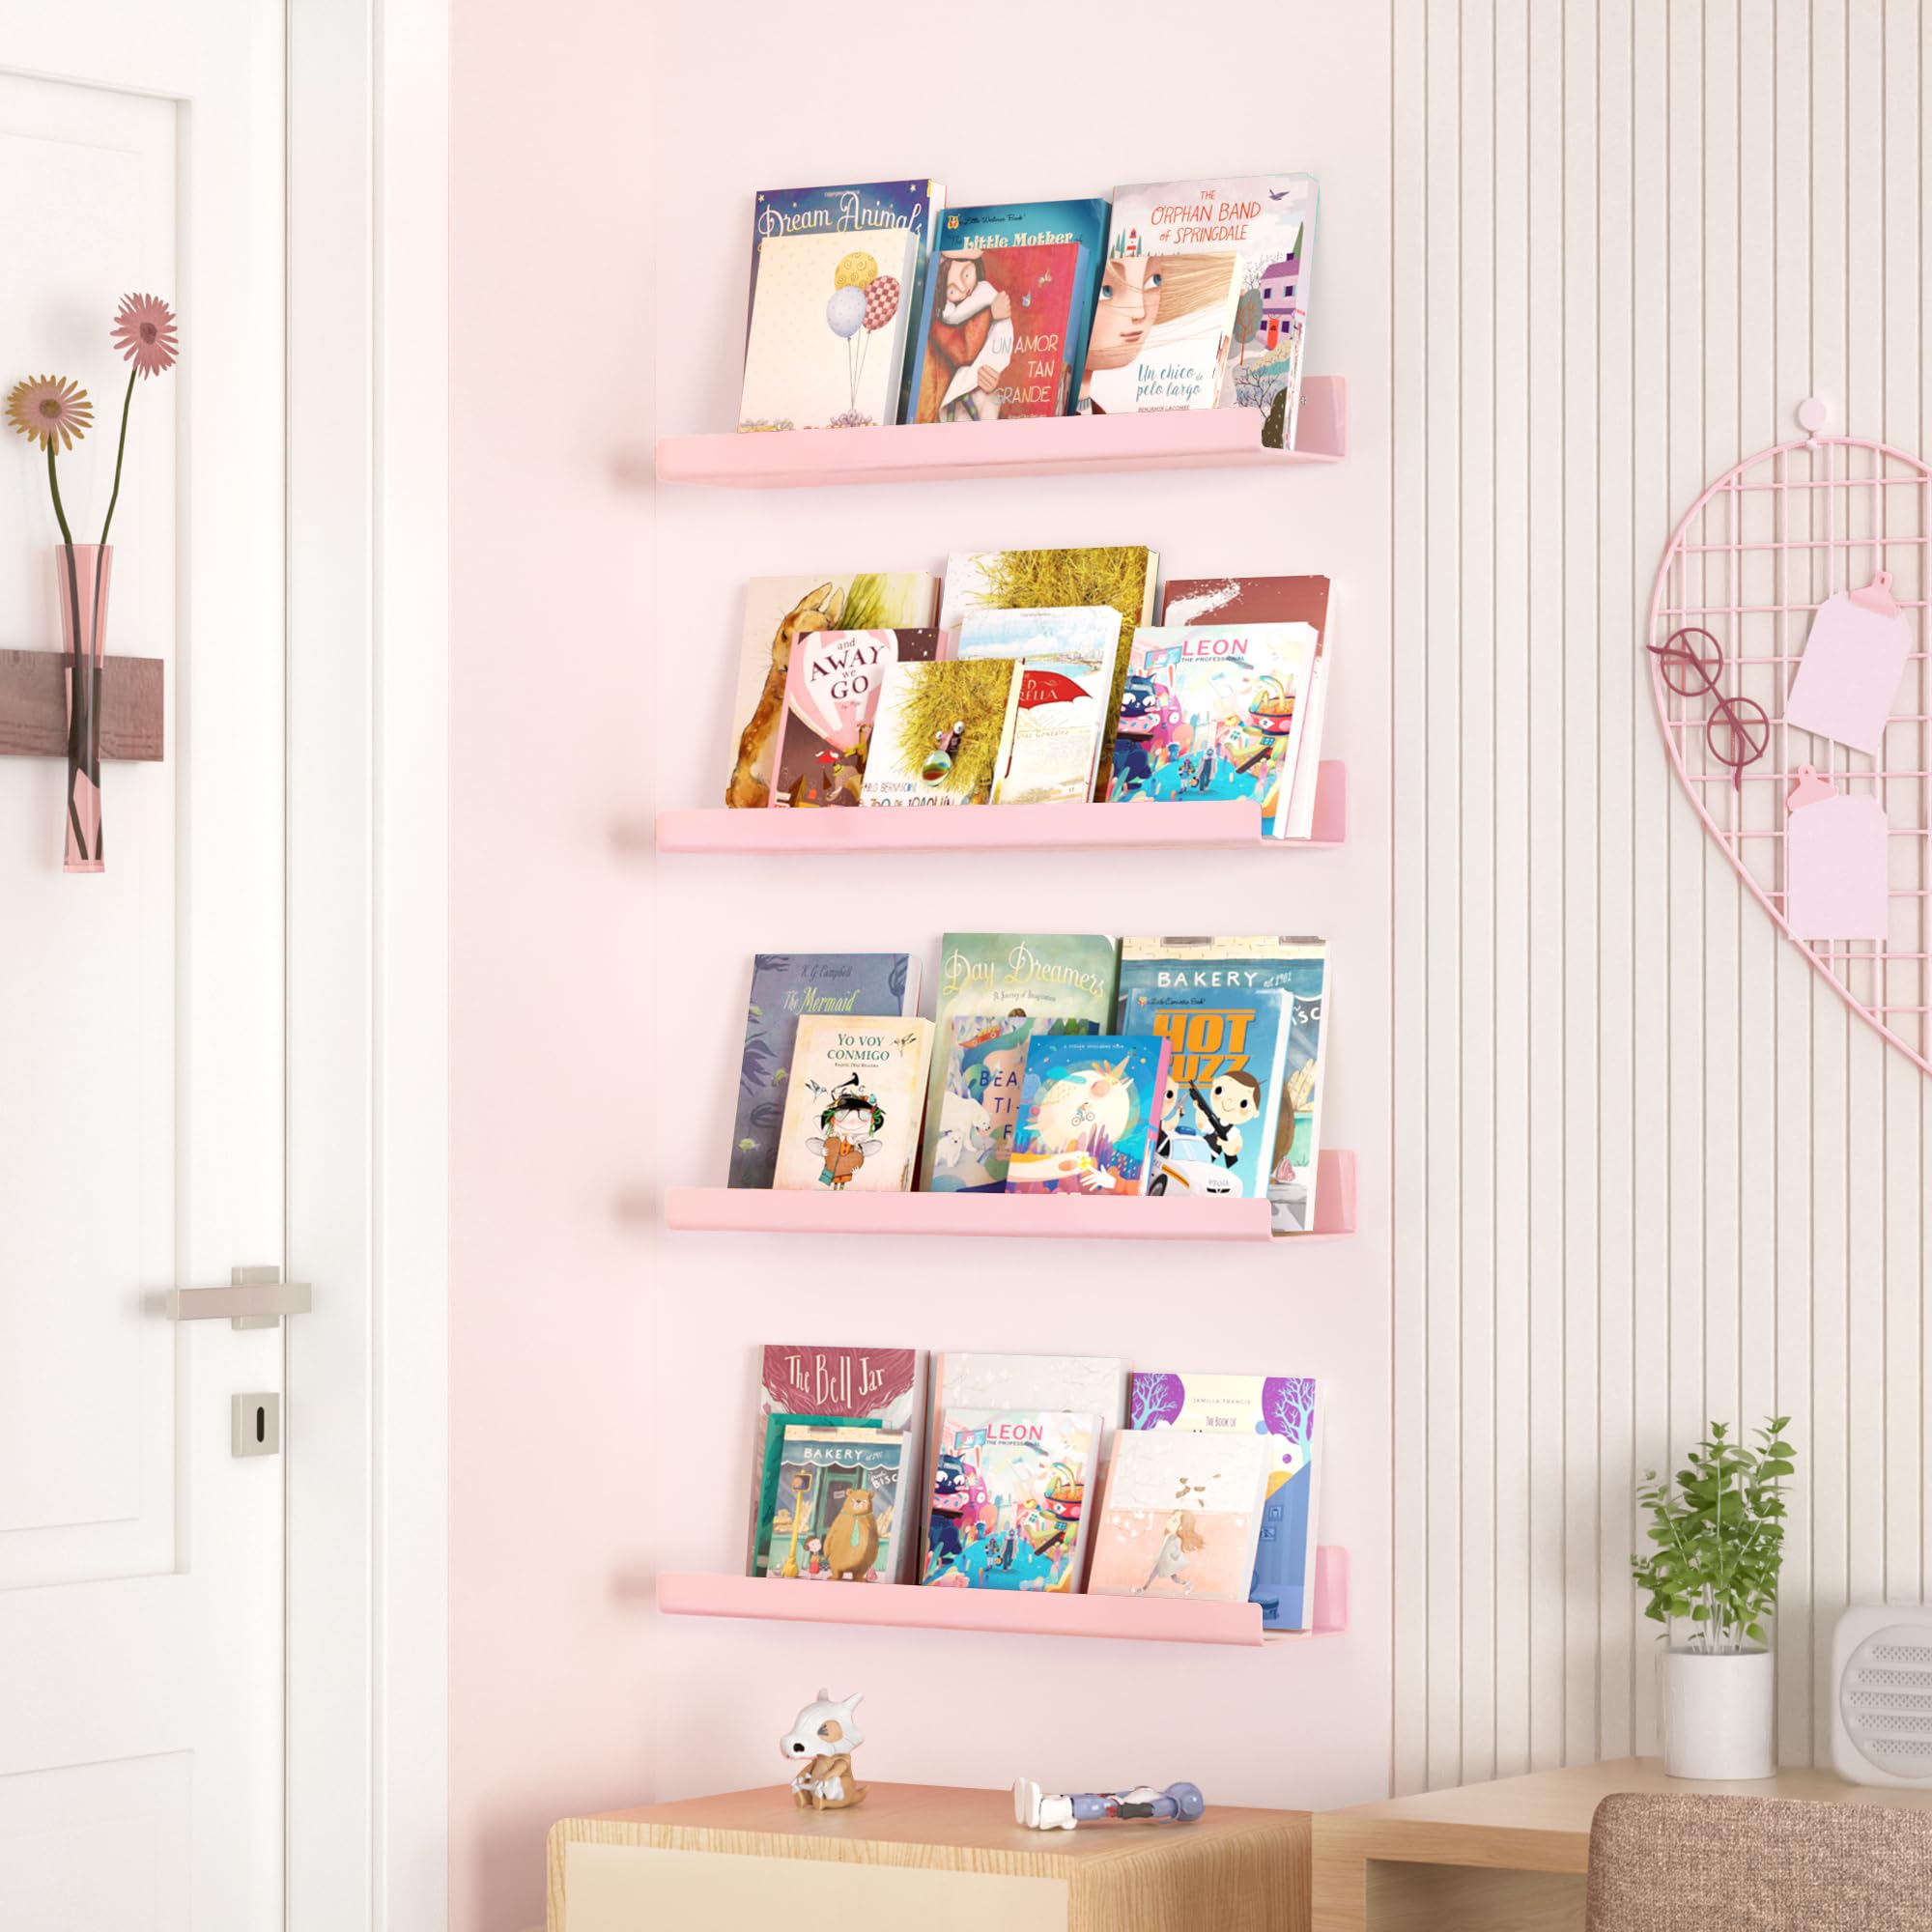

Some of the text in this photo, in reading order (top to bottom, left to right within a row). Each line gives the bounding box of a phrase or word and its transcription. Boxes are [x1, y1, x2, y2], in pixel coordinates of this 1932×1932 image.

[1201, 189, 1216, 200] THE
[757, 204, 833, 238] Dream
[1151, 201, 1262, 225] ORPHAN BAND
[963, 235, 1009, 249] Little
[1014, 231, 1073, 246] Mother
[1159, 224, 1248, 244] of SPRINGDALE
[991, 334, 1059, 354] UN AMOR
[1028, 360, 1055, 378] TAN
[1138, 364, 1155, 382] Un
[1160, 363, 1195, 380] chico
[991, 386, 1051, 405] GRANDE
[1136, 381, 1202, 402] pelo largo
[838, 638, 856, 650] and
[1182, 638, 1248, 656] LEON
[810, 646, 885, 682] AWAY
[842, 669, 856, 678] we
[831, 675, 868, 699] GO
[943, 941, 1104, 998] Day Dreamers
[1158, 971, 1258, 987] BAKERY
[782, 985, 861, 1014] The Mermaid
[859, 1036, 884, 1047] VOY
[1153, 1014, 1255, 1053] HOT
[827, 1049, 890, 1061] CONMIGO
[1169, 1054, 1250, 1083] UZZ
[784, 1353, 885, 1409] The Bell Jar
[987, 1423, 1043, 1440] LEON
[804, 1448, 863, 1460] BAKERY
